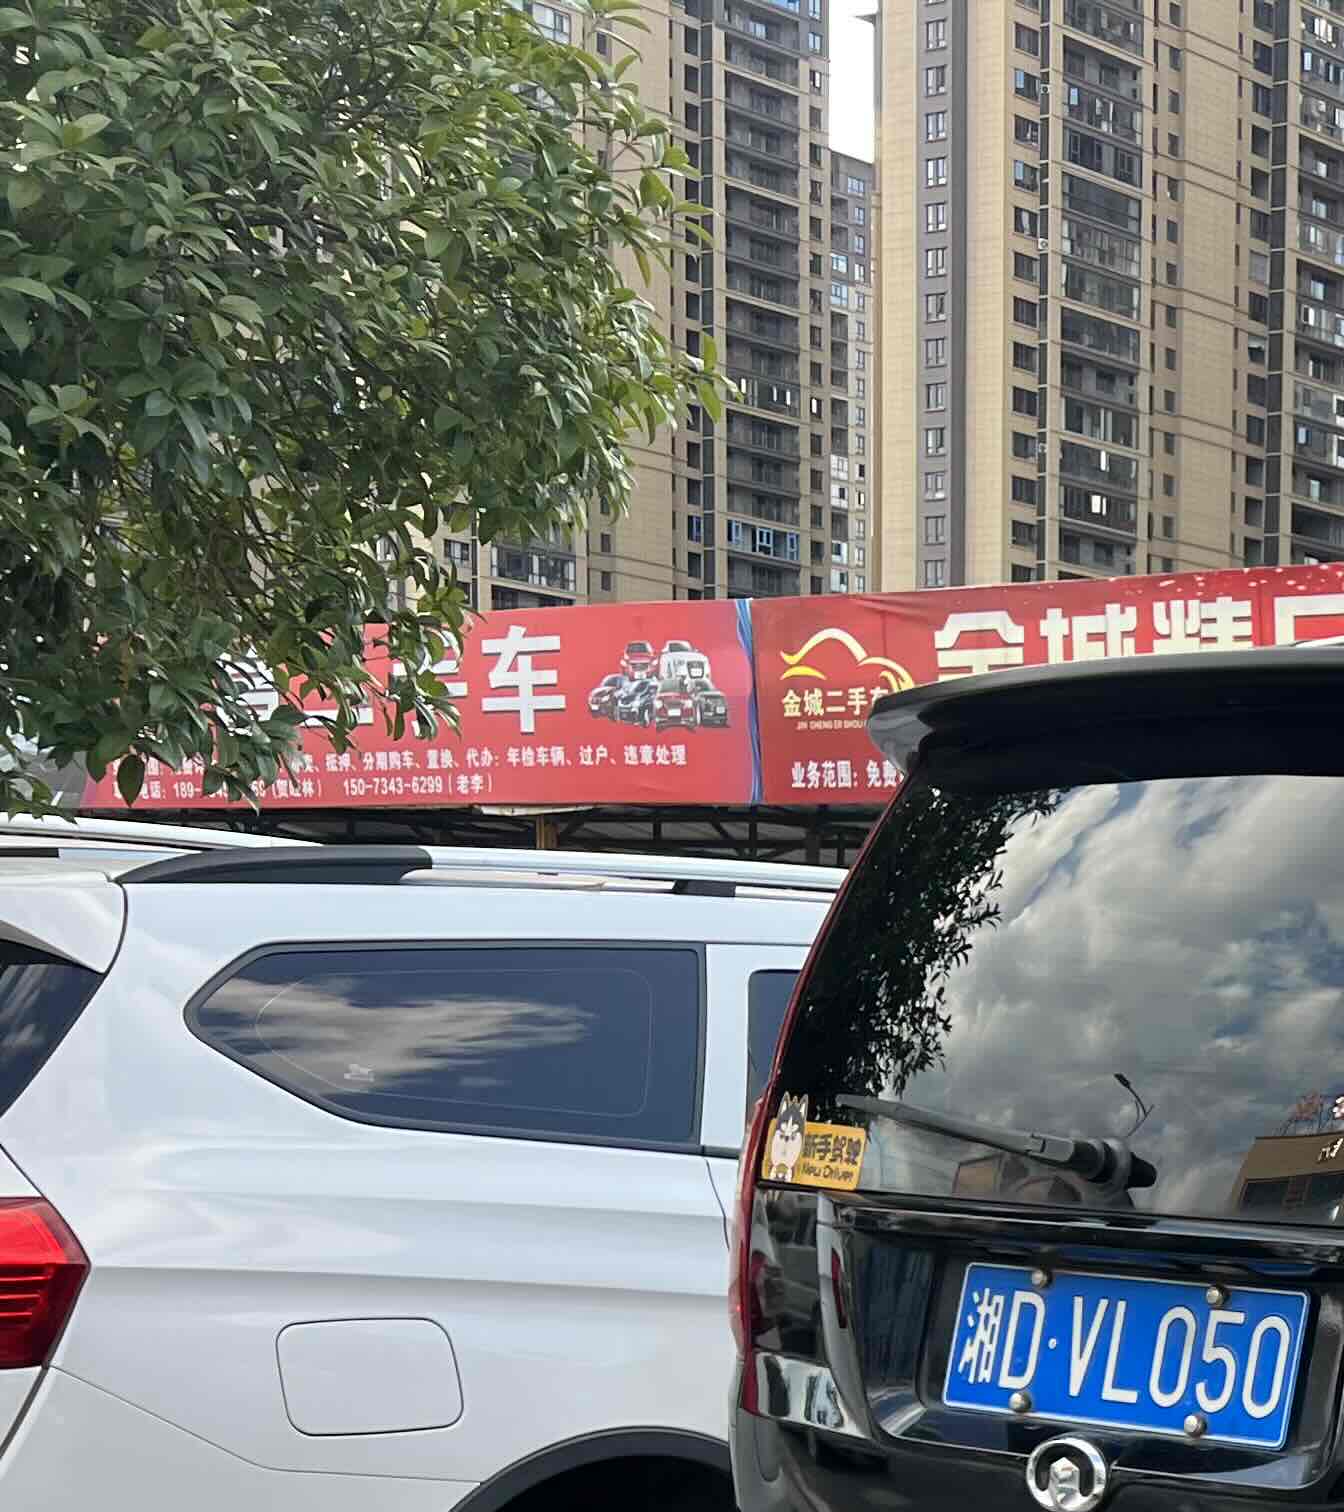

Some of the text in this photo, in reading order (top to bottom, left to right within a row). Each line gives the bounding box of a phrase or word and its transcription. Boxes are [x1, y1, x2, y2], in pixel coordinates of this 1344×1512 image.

[791, 760, 904, 788] 业务范围：免费
[958, 1287, 1292, 1420] 湘D·VL050
